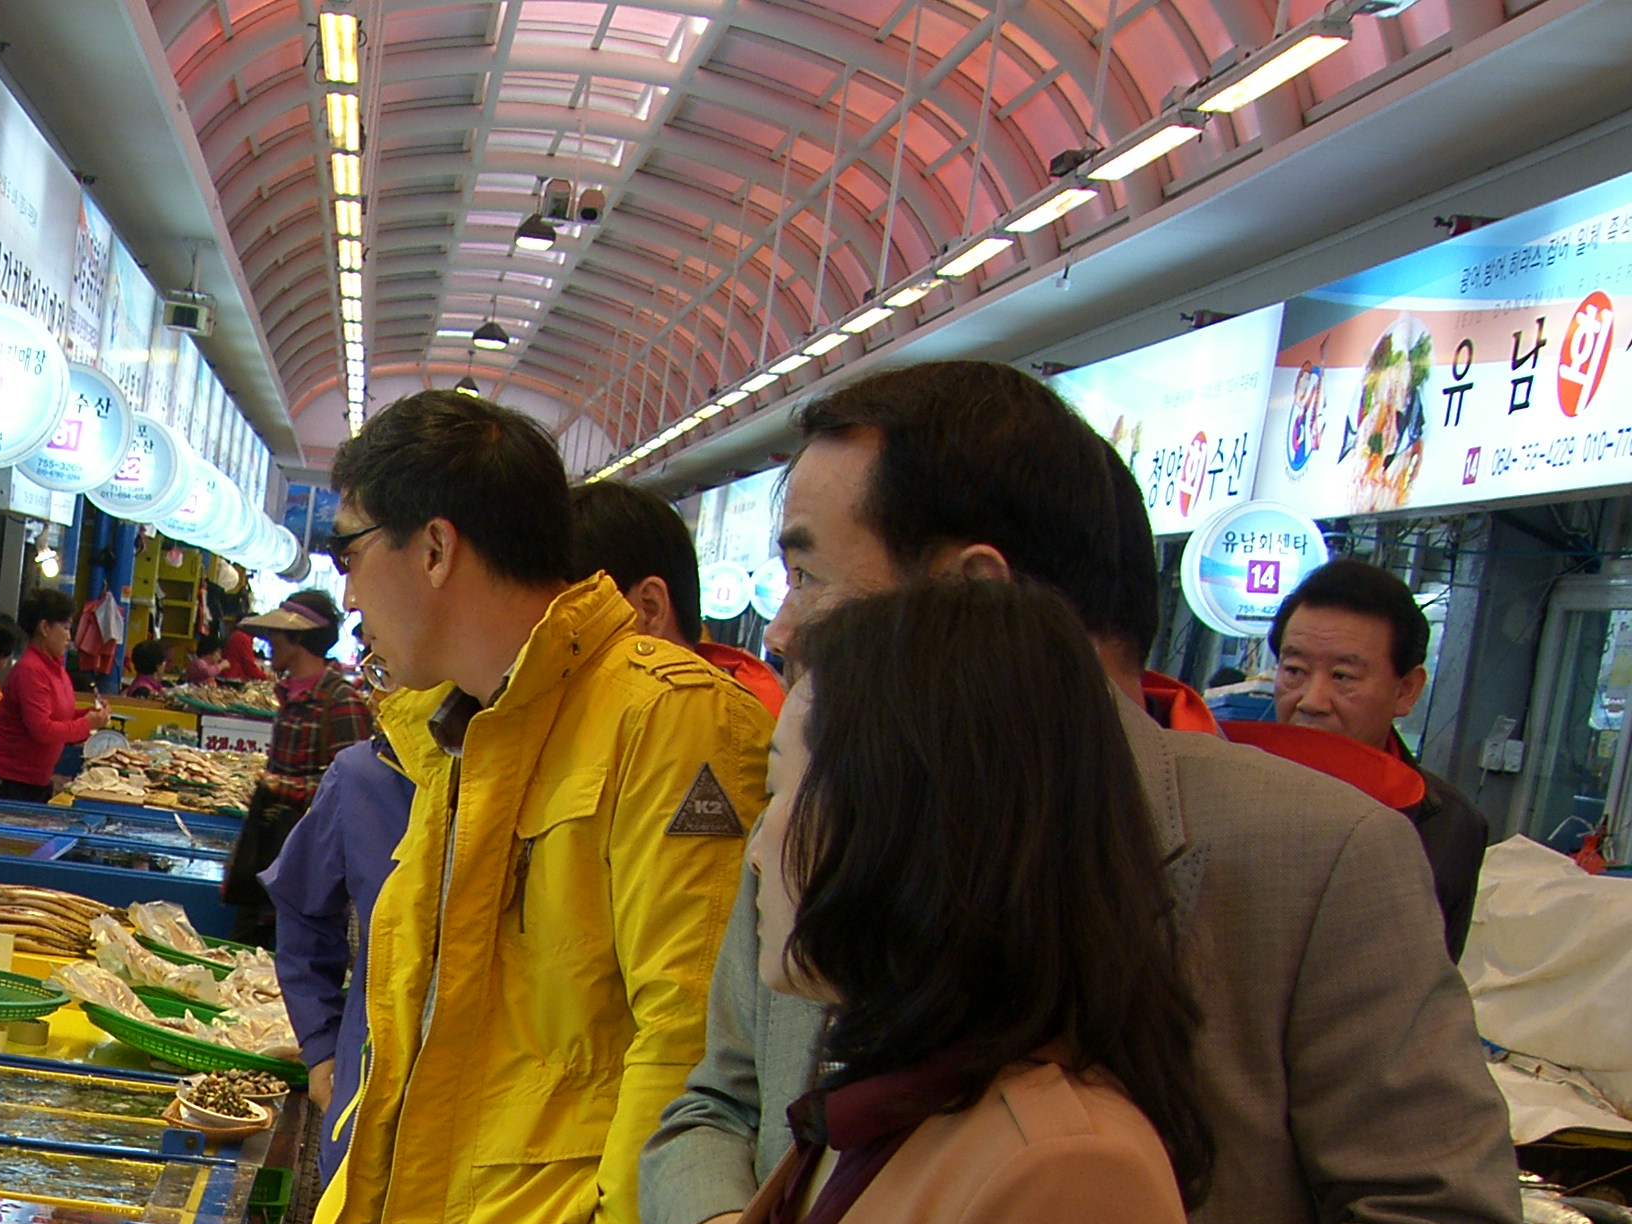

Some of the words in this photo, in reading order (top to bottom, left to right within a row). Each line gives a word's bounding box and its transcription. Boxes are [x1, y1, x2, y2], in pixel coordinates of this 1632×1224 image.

[1222, 530, 1309, 556] 유남회센타
[1250, 563, 1276, 590] 14
[694, 800, 724, 815] K2
